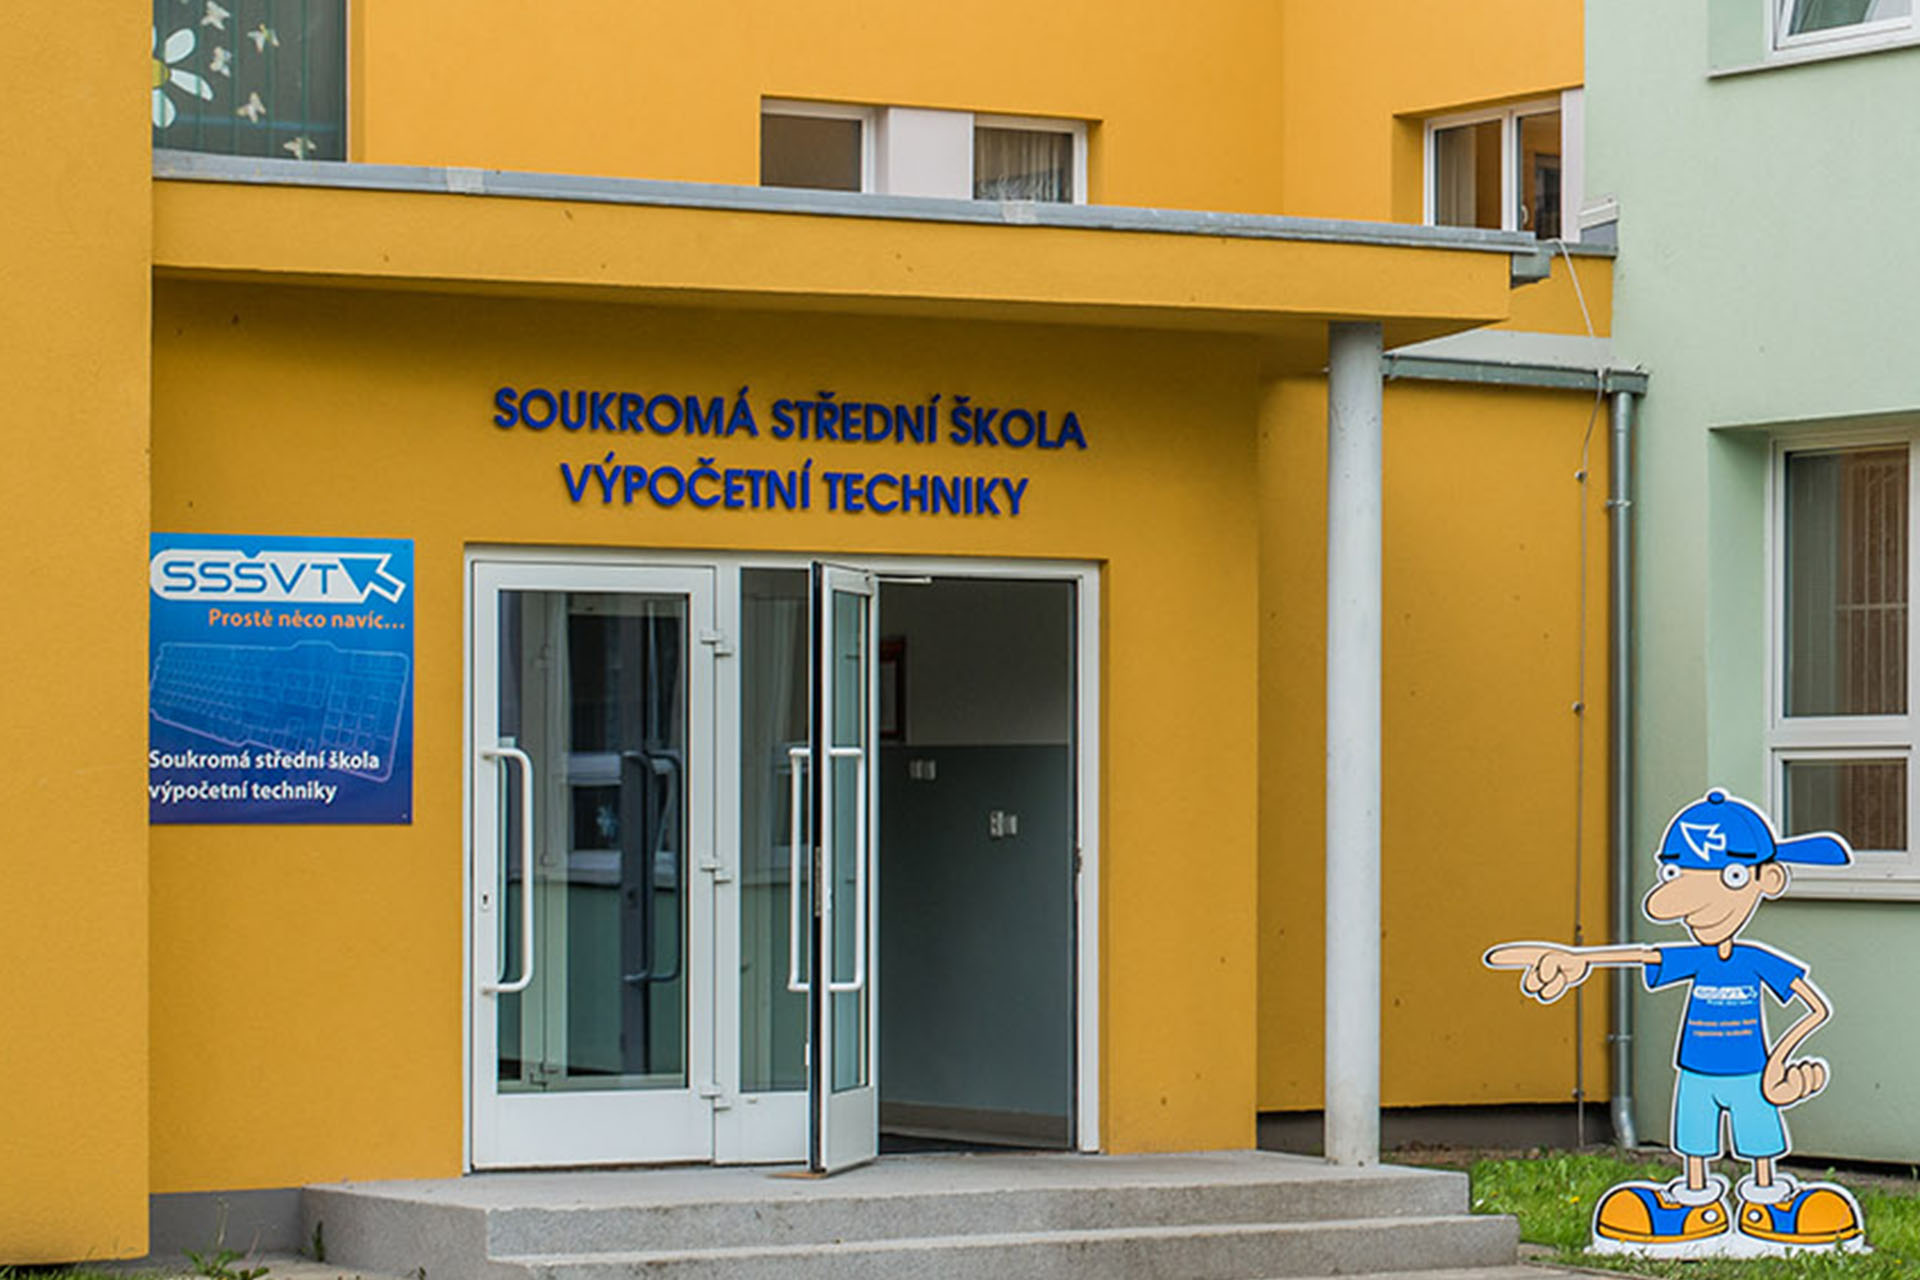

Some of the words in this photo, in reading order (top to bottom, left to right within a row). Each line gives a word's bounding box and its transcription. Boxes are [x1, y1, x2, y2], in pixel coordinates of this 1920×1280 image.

[493, 386, 759, 437] SOUKROMÁ
[771, 391, 940, 444] STŘEDNÍ
[949, 396, 1088, 449] ŠKOLA
[560, 451, 812, 509] VÝPOČETNÍ
[823, 471, 1029, 515] TECHNIKY
[162, 553, 339, 595] SSŠVT
[208, 608, 273, 628] Prostě
[278, 609, 326, 628] něco
[149, 749, 251, 769] Soukromá
[255, 749, 325, 769] střední
[328, 750, 380, 769] škola
[148, 780, 249, 804] výpočetní
[251, 780, 337, 804] techniky
